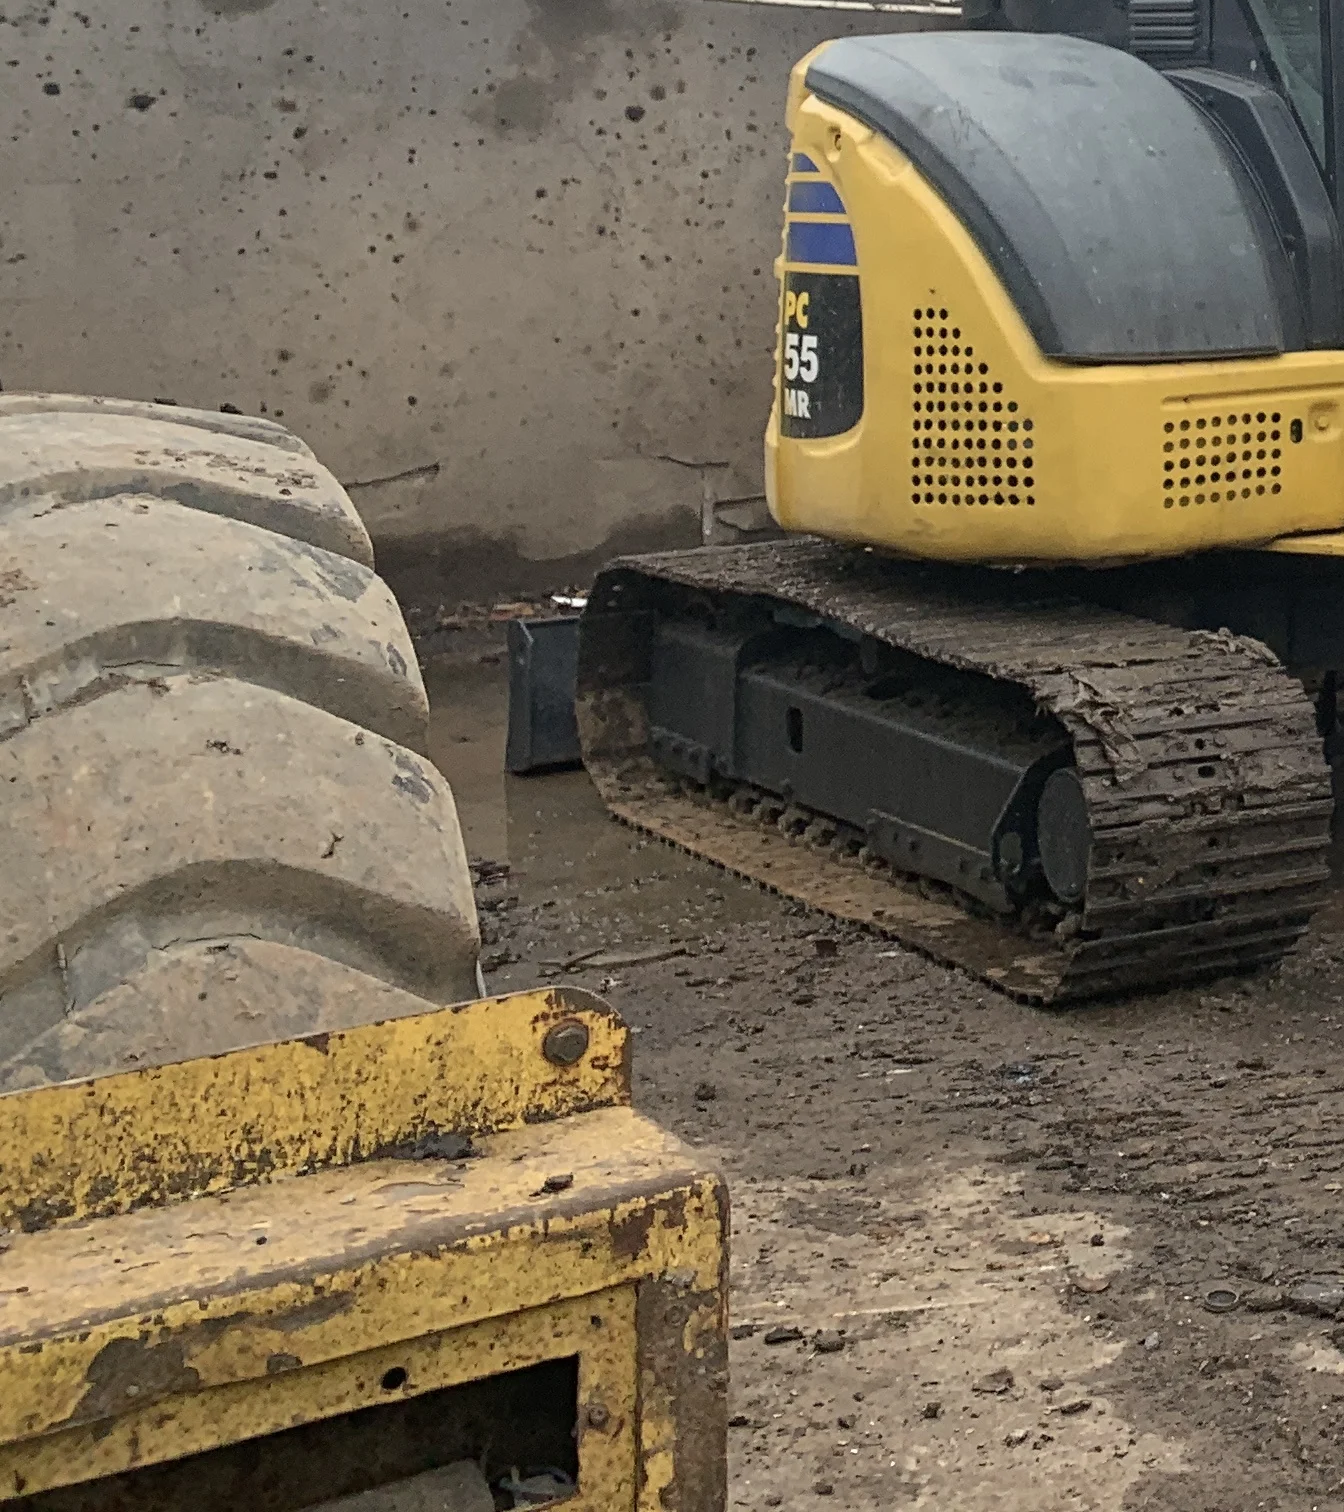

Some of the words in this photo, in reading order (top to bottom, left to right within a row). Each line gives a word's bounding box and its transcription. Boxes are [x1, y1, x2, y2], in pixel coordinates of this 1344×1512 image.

[784, 290, 809, 328] PC
[784, 333, 819, 383] 55
[784, 388, 811, 419] MR
